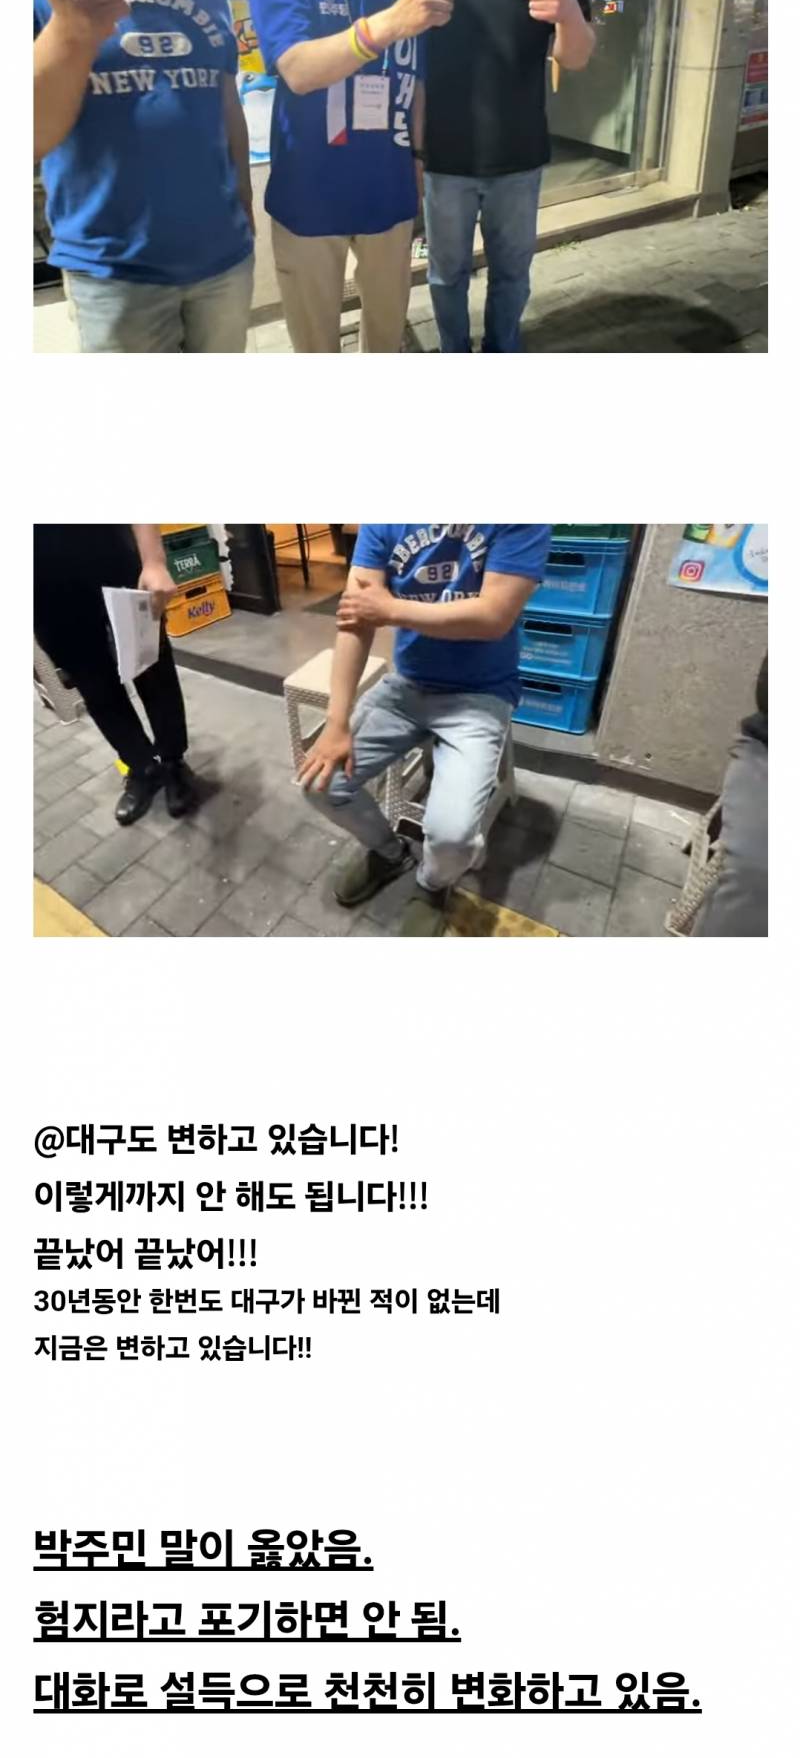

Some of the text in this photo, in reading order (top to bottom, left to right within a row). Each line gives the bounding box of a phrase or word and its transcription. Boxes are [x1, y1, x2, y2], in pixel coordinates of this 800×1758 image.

[138, 35, 174, 54] 92
[89, 67, 220, 96] NEW YORK
[173, 552, 202, 573] TERRA
[427, 563, 453, 582] 92
[187, 599, 215, 620] Kelly
